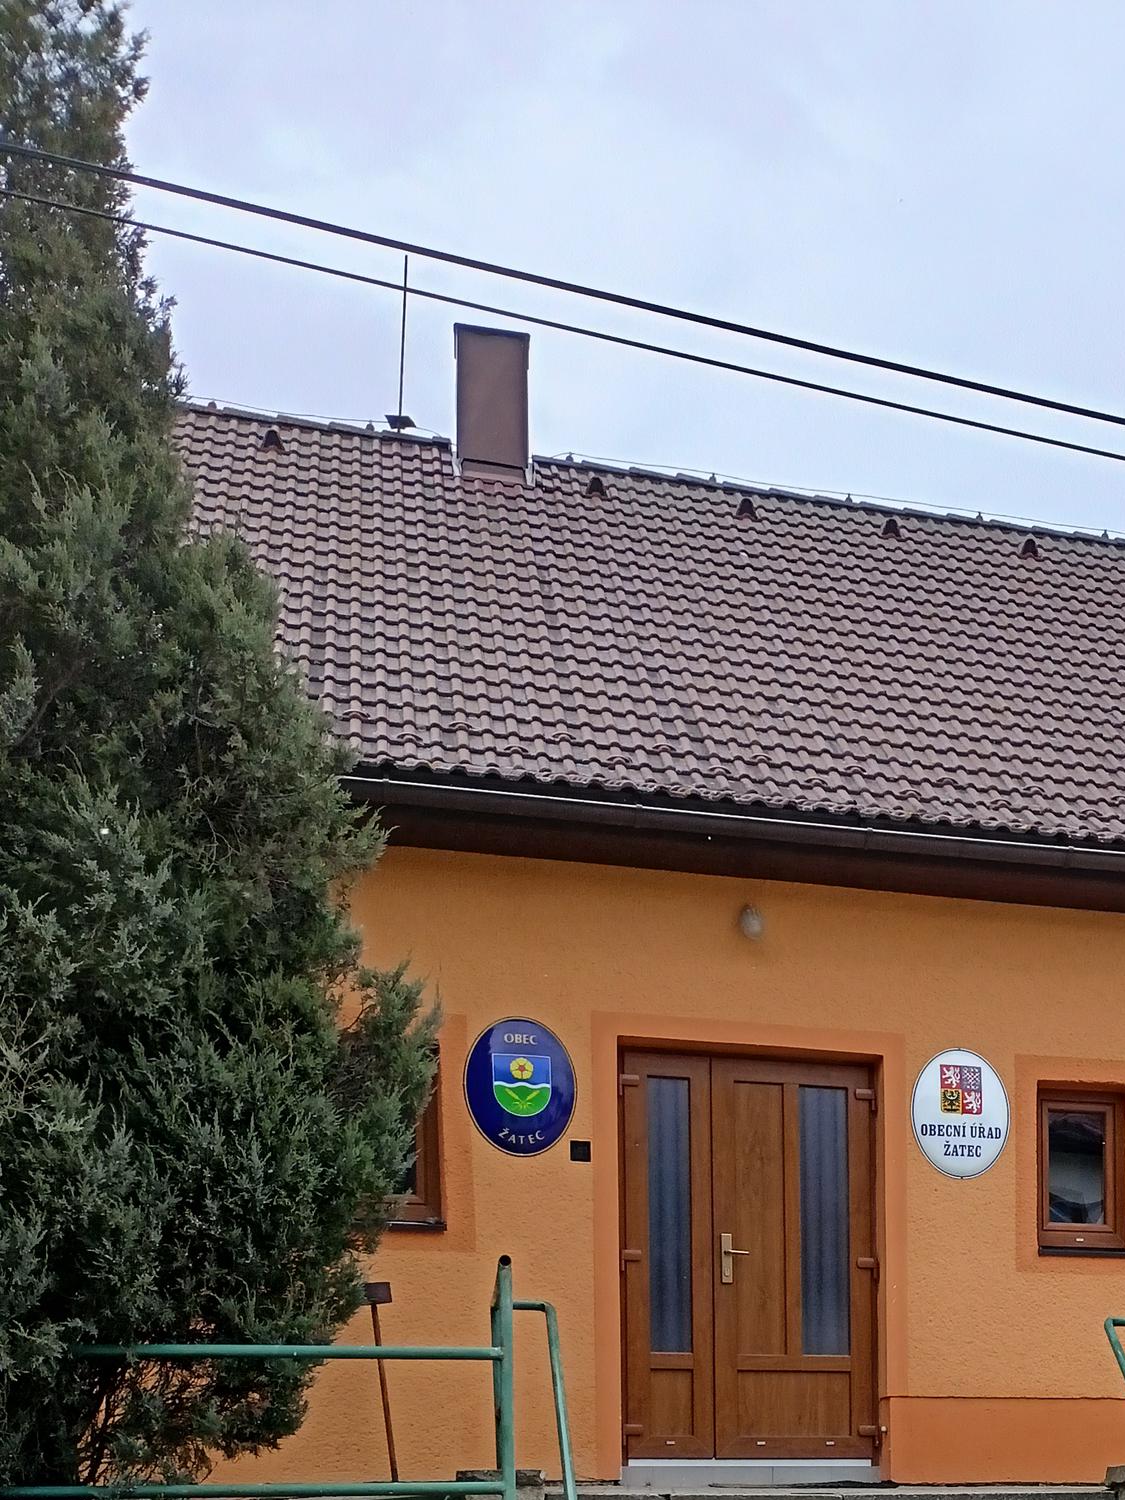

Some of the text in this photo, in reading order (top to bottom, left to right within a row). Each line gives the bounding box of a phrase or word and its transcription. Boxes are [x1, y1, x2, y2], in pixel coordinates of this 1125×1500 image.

[504, 1033, 538, 1045] OBEC
[498, 1127, 545, 1144] ŽATEC
[921, 1122, 1001, 1139] OBECNÍ ÚŘAD
[944, 1141, 981, 1157] ŽATEC
